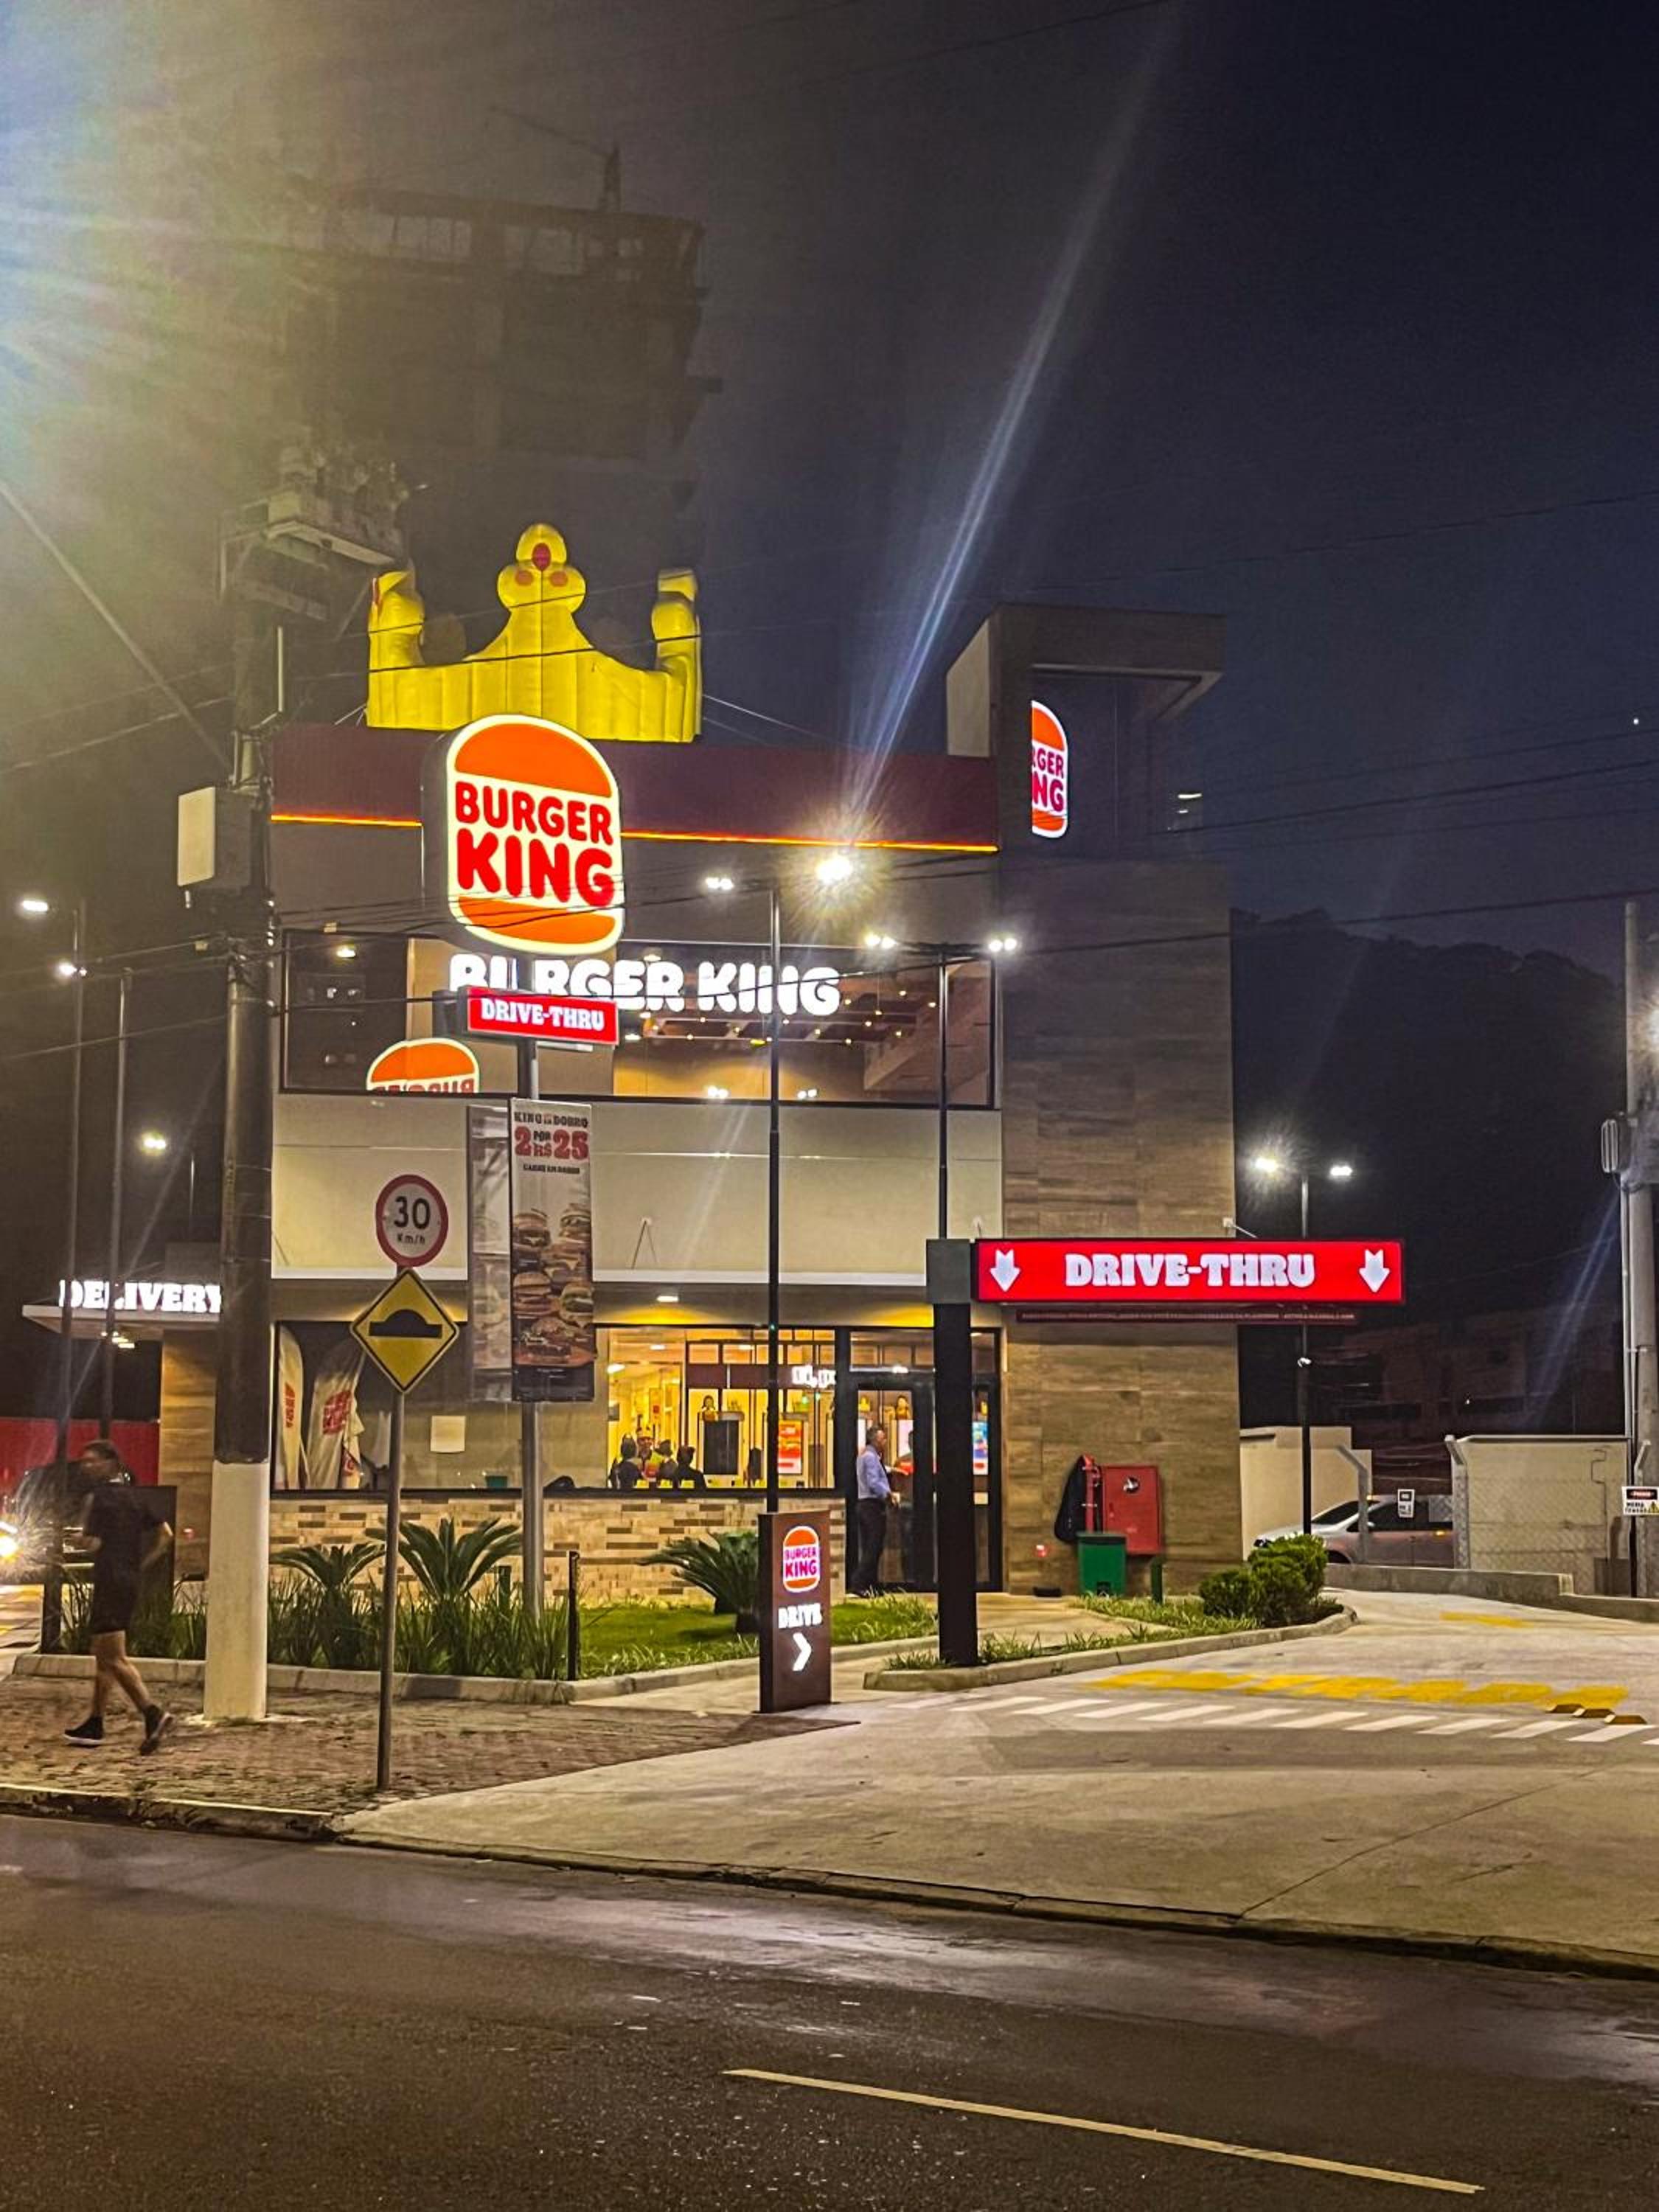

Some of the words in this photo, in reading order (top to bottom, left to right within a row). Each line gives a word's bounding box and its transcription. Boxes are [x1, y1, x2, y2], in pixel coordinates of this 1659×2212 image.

[454, 781, 613, 845] BURGER
[456, 828, 615, 906] KING
[698, 961, 841, 1016] KING
[481, 998, 605, 1031] DRIVE-THRU
[515, 1126, 532, 1156] 2
[553, 1129, 589, 1160] 25
[394, 1195, 431, 1230] 30
[1065, 1253, 1315, 1287] DRIVE-THRU
[784, 1547, 817, 1559] BURGER
[785, 1559, 817, 1578] KING
[778, 1602, 822, 1629] DRIVE
